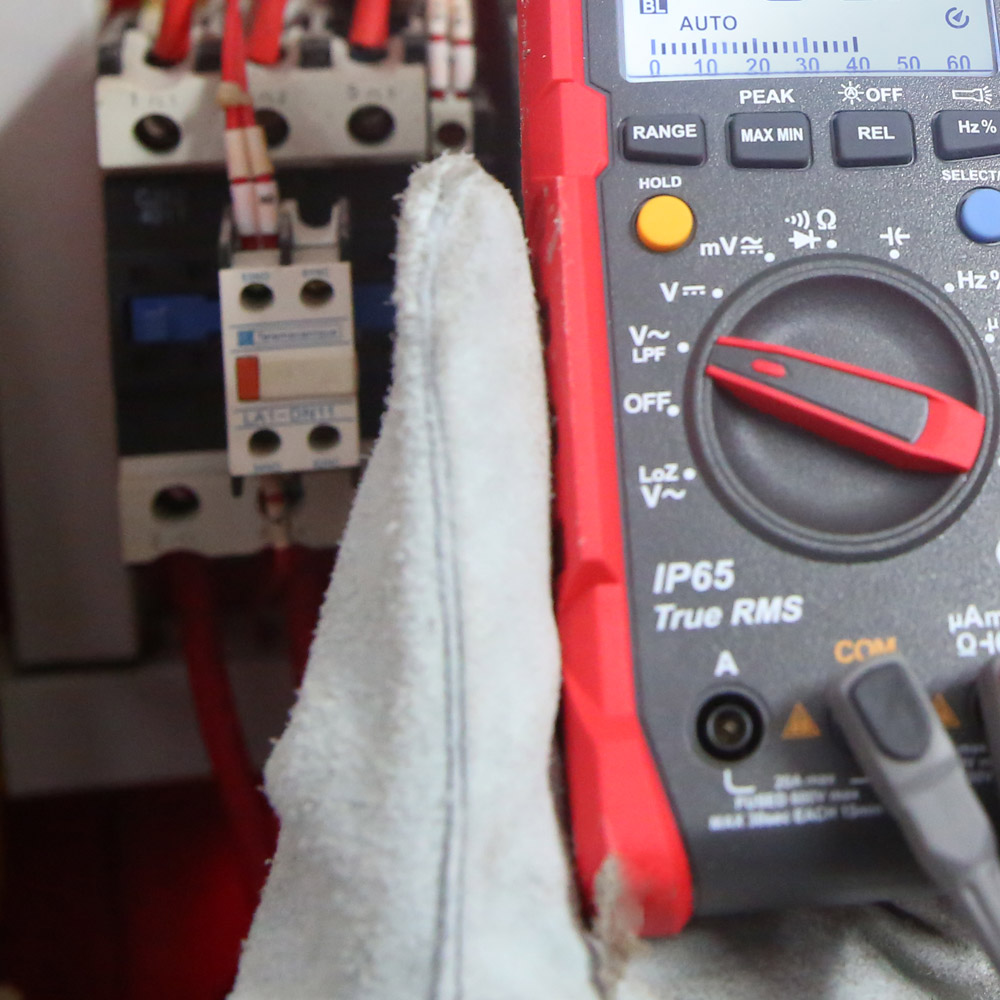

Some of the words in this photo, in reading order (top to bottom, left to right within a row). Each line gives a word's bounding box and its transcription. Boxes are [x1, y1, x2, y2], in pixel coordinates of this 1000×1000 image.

[642, 0, 667, 14] BL
[679, 15, 738, 31] AUTO
[649, 59, 661, 75] 0
[695, 59, 718, 75] 10
[746, 58, 770, 72] 20
[796, 57, 820, 72] 30
[846, 56, 870, 71] 40
[897, 56, 921, 70] 50
[947, 55, 971, 70] 60
[739, 89, 795, 104] PEAK
[865, 88, 903, 101] OFF
[632, 124, 697, 140] RANGE
[741, 127, 774, 143] MAX
[777, 127, 804, 143] MIN
[857, 126, 896, 141] REL
[638, 176, 682, 190] HOLD
[632, 347, 667, 364] LPF
[623, 393, 671, 415] OFF
[639, 465, 680, 484] LoZ
[652, 559, 735, 595] IP65
[654, 602, 724, 632] True
[731, 595, 804, 627] RMS
[833, 636, 898, 664] COM
[714, 651, 740, 677] A
